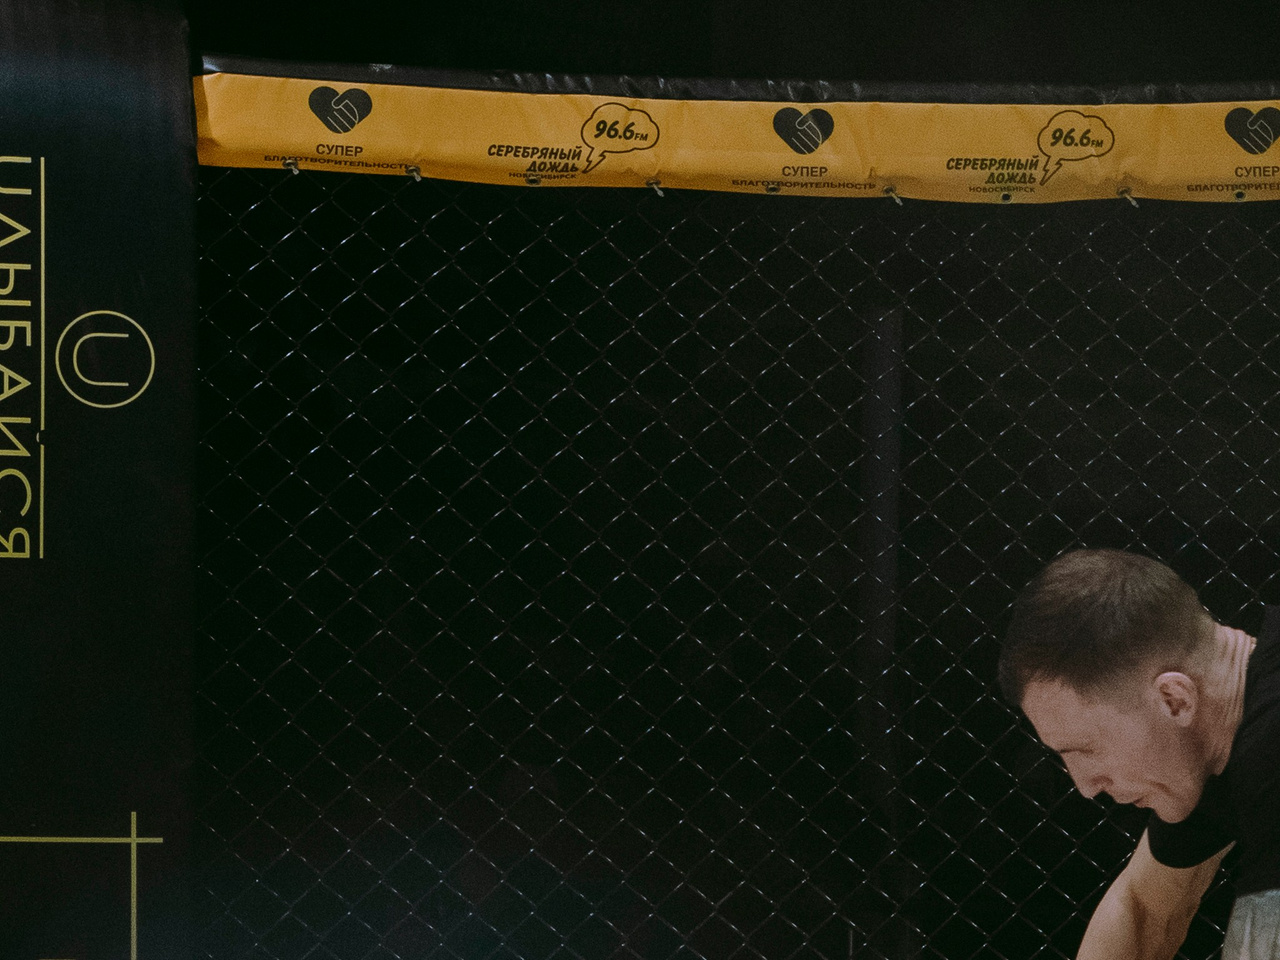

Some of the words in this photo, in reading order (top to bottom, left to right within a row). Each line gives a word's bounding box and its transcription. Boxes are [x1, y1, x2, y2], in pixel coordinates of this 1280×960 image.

[316, 143, 364, 158] СУПЕР
[487, 144, 583, 161] СЕРЕБРЯНЫЙ
[526, 161, 580, 173] ДОЖДЬ
[946, 155, 1040, 171] СЕРЕБРЯНЫЙ
[781, 165, 829, 178] СУПЕР
[1234, 165, 1280, 178] СУПЕР
[985, 172, 1037, 185] ДОЖДЬ
[968, 186, 1036, 194] НОВОСИБИРСК
